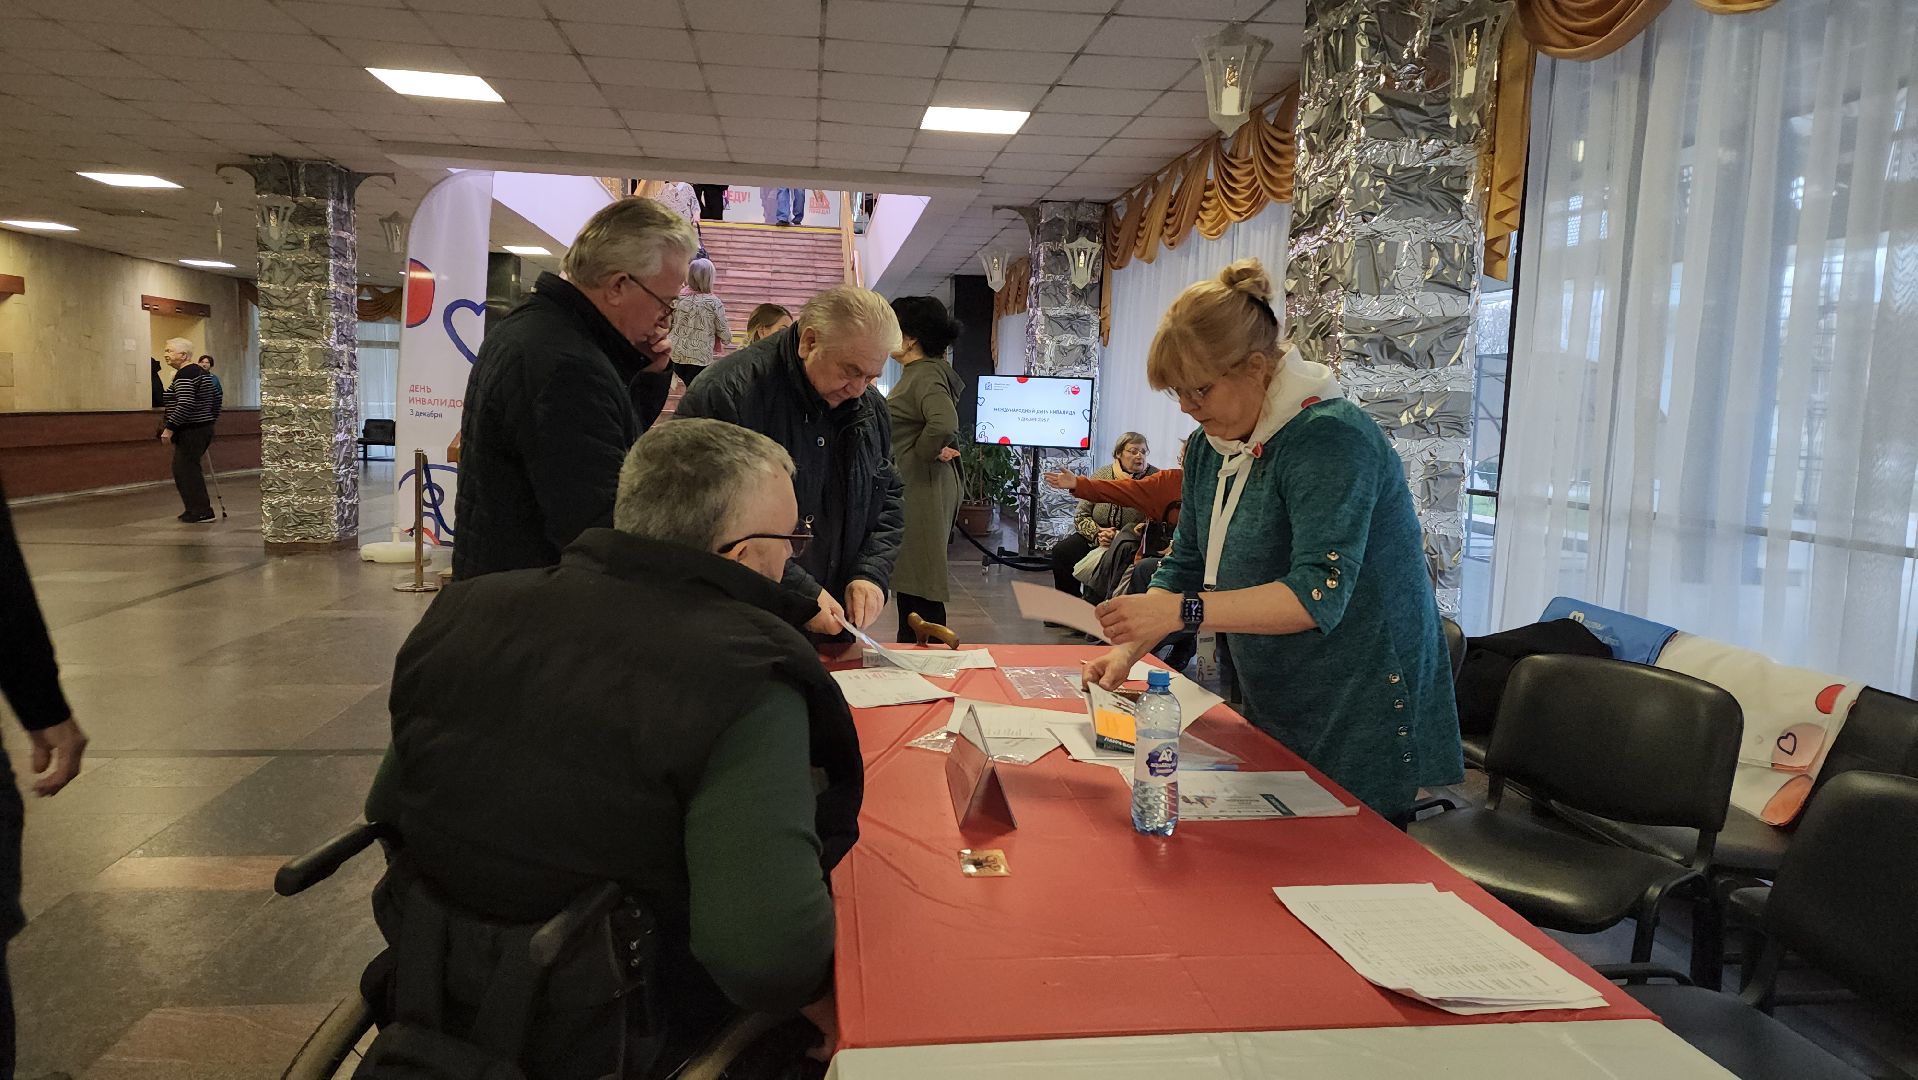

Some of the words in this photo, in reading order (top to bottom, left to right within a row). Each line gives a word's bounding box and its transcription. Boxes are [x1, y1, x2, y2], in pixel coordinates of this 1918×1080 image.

[727, 190, 750, 203] ЕДУ!
[409, 384, 432, 393] ДЕНЬ
[415, 410, 443, 419] декабря
